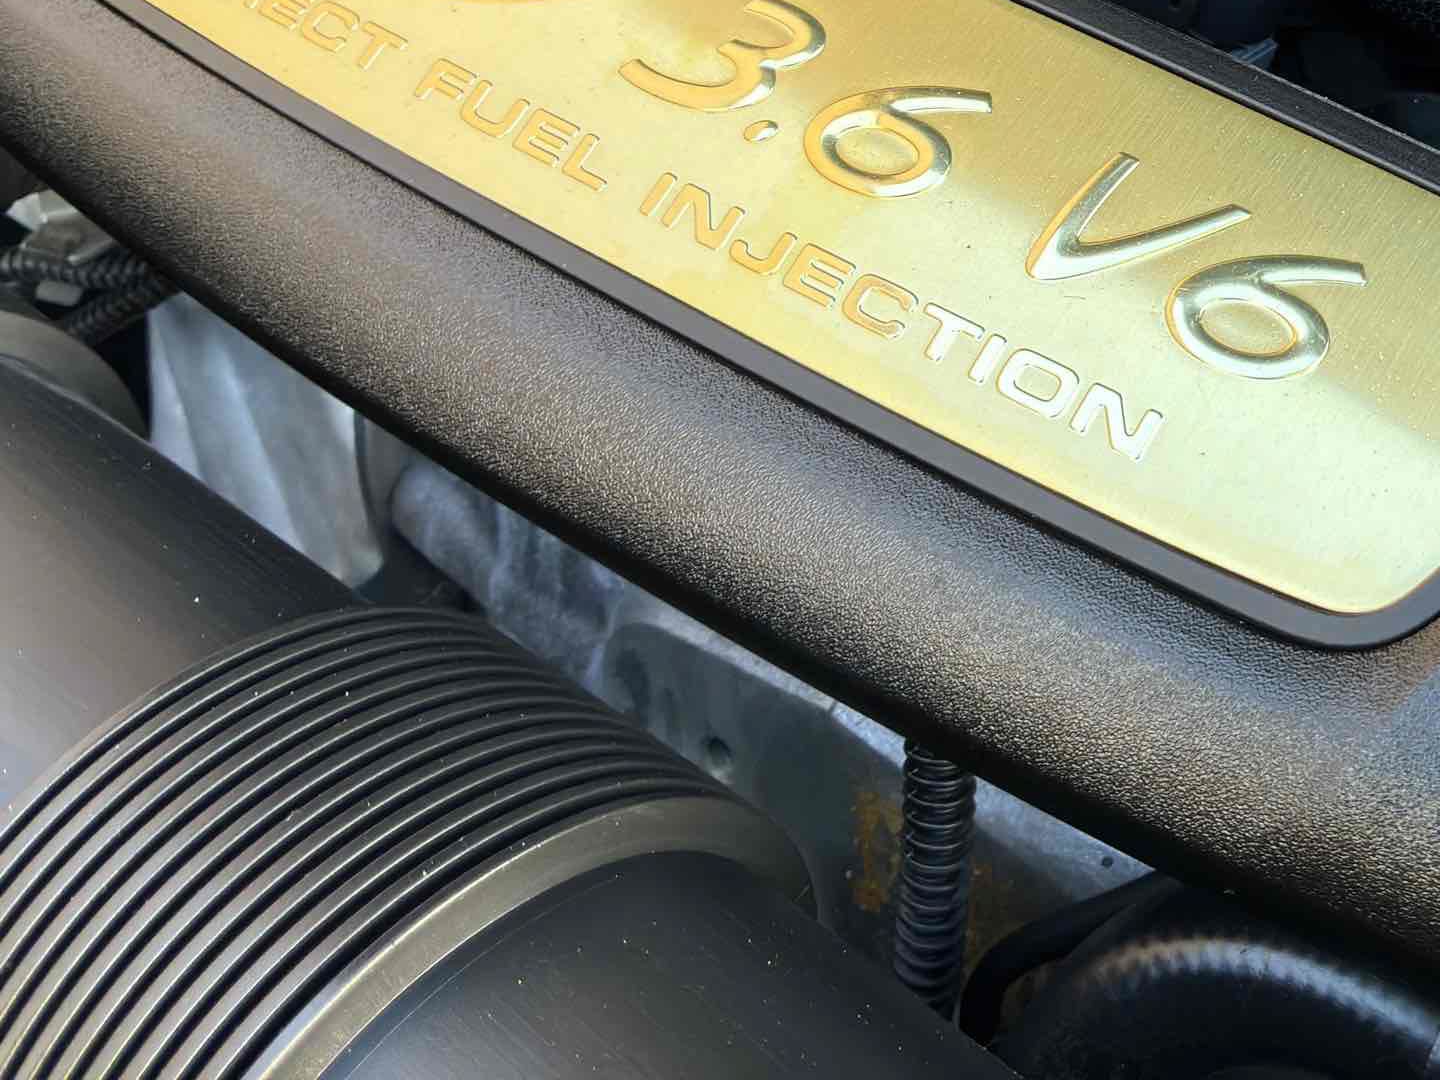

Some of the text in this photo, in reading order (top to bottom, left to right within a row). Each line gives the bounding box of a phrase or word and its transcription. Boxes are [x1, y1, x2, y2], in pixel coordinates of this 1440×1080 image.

[415, 58, 608, 192] FUEL
[640, 172, 1164, 461] INJECTION
[1025, 152, 1367, 380] V6
